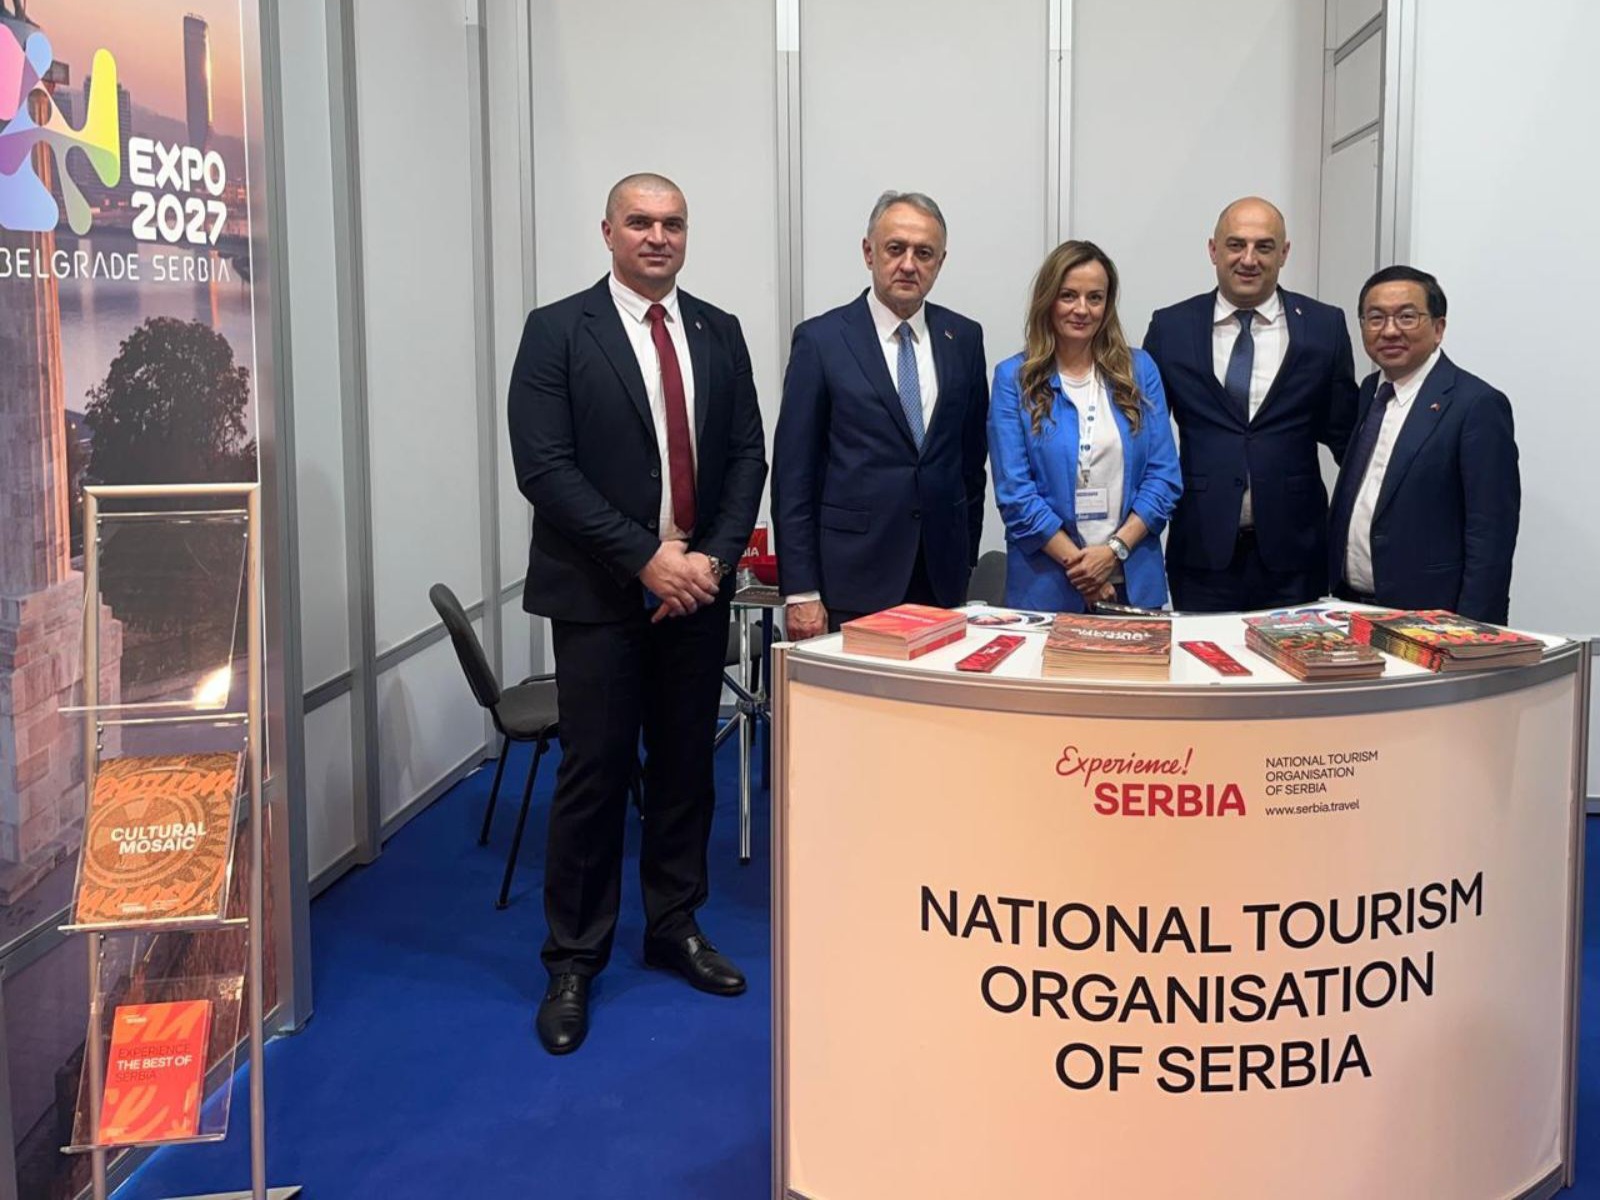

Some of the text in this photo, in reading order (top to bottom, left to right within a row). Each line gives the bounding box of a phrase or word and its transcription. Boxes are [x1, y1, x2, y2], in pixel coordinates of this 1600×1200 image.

[128, 136, 226, 197] EXPO
[131, 191, 227, 246] 2027
[152, 254, 231, 283] SERBIA
[1055, 745, 1193, 787] Experience!
[1265, 750, 1378, 769] NATIONAL TOURISM
[1265, 766, 1355, 783] ORGANISATION
[1093, 782, 1246, 817] SERBIA
[1265, 782, 1327, 796] OF SERBIA
[1265, 799, 1360, 816] www.serbia.travel
[110, 820, 207, 842] CULTURAL
[119, 836, 196, 855] MOSAIC
[920, 871, 1483, 953] NATIONAL TOURISM
[980, 951, 1435, 1024] ORGANISATION
[118, 1043, 191, 1059] EXPERIENCE
[116, 1055, 193, 1071] THE BEST OF
[1055, 1034, 1372, 1094] OF SERBIA
[115, 1070, 157, 1083] SERBIA
